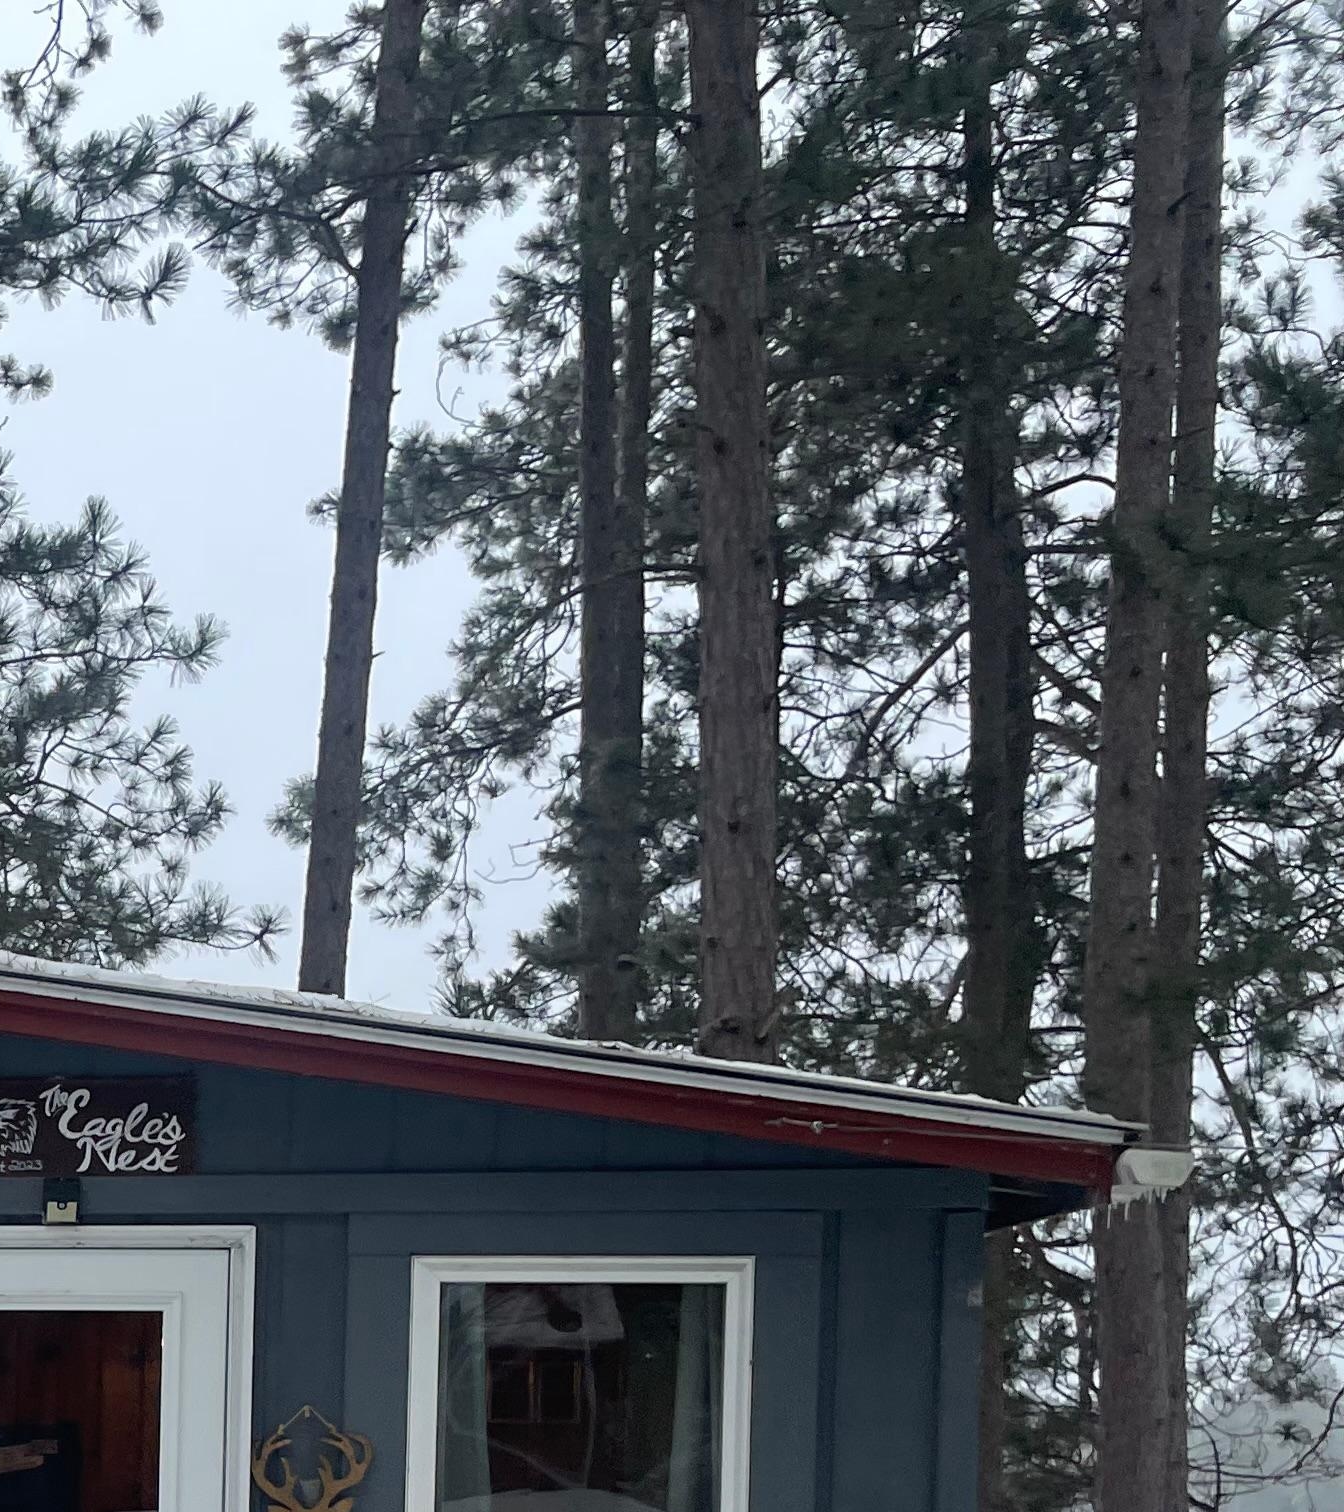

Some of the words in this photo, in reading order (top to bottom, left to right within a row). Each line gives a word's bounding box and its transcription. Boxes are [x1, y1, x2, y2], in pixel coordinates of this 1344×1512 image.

[39, 1084, 69, 1117] The
[58, 1088, 185, 1151] Eagle's
[76, 1136, 179, 1172] Nest
